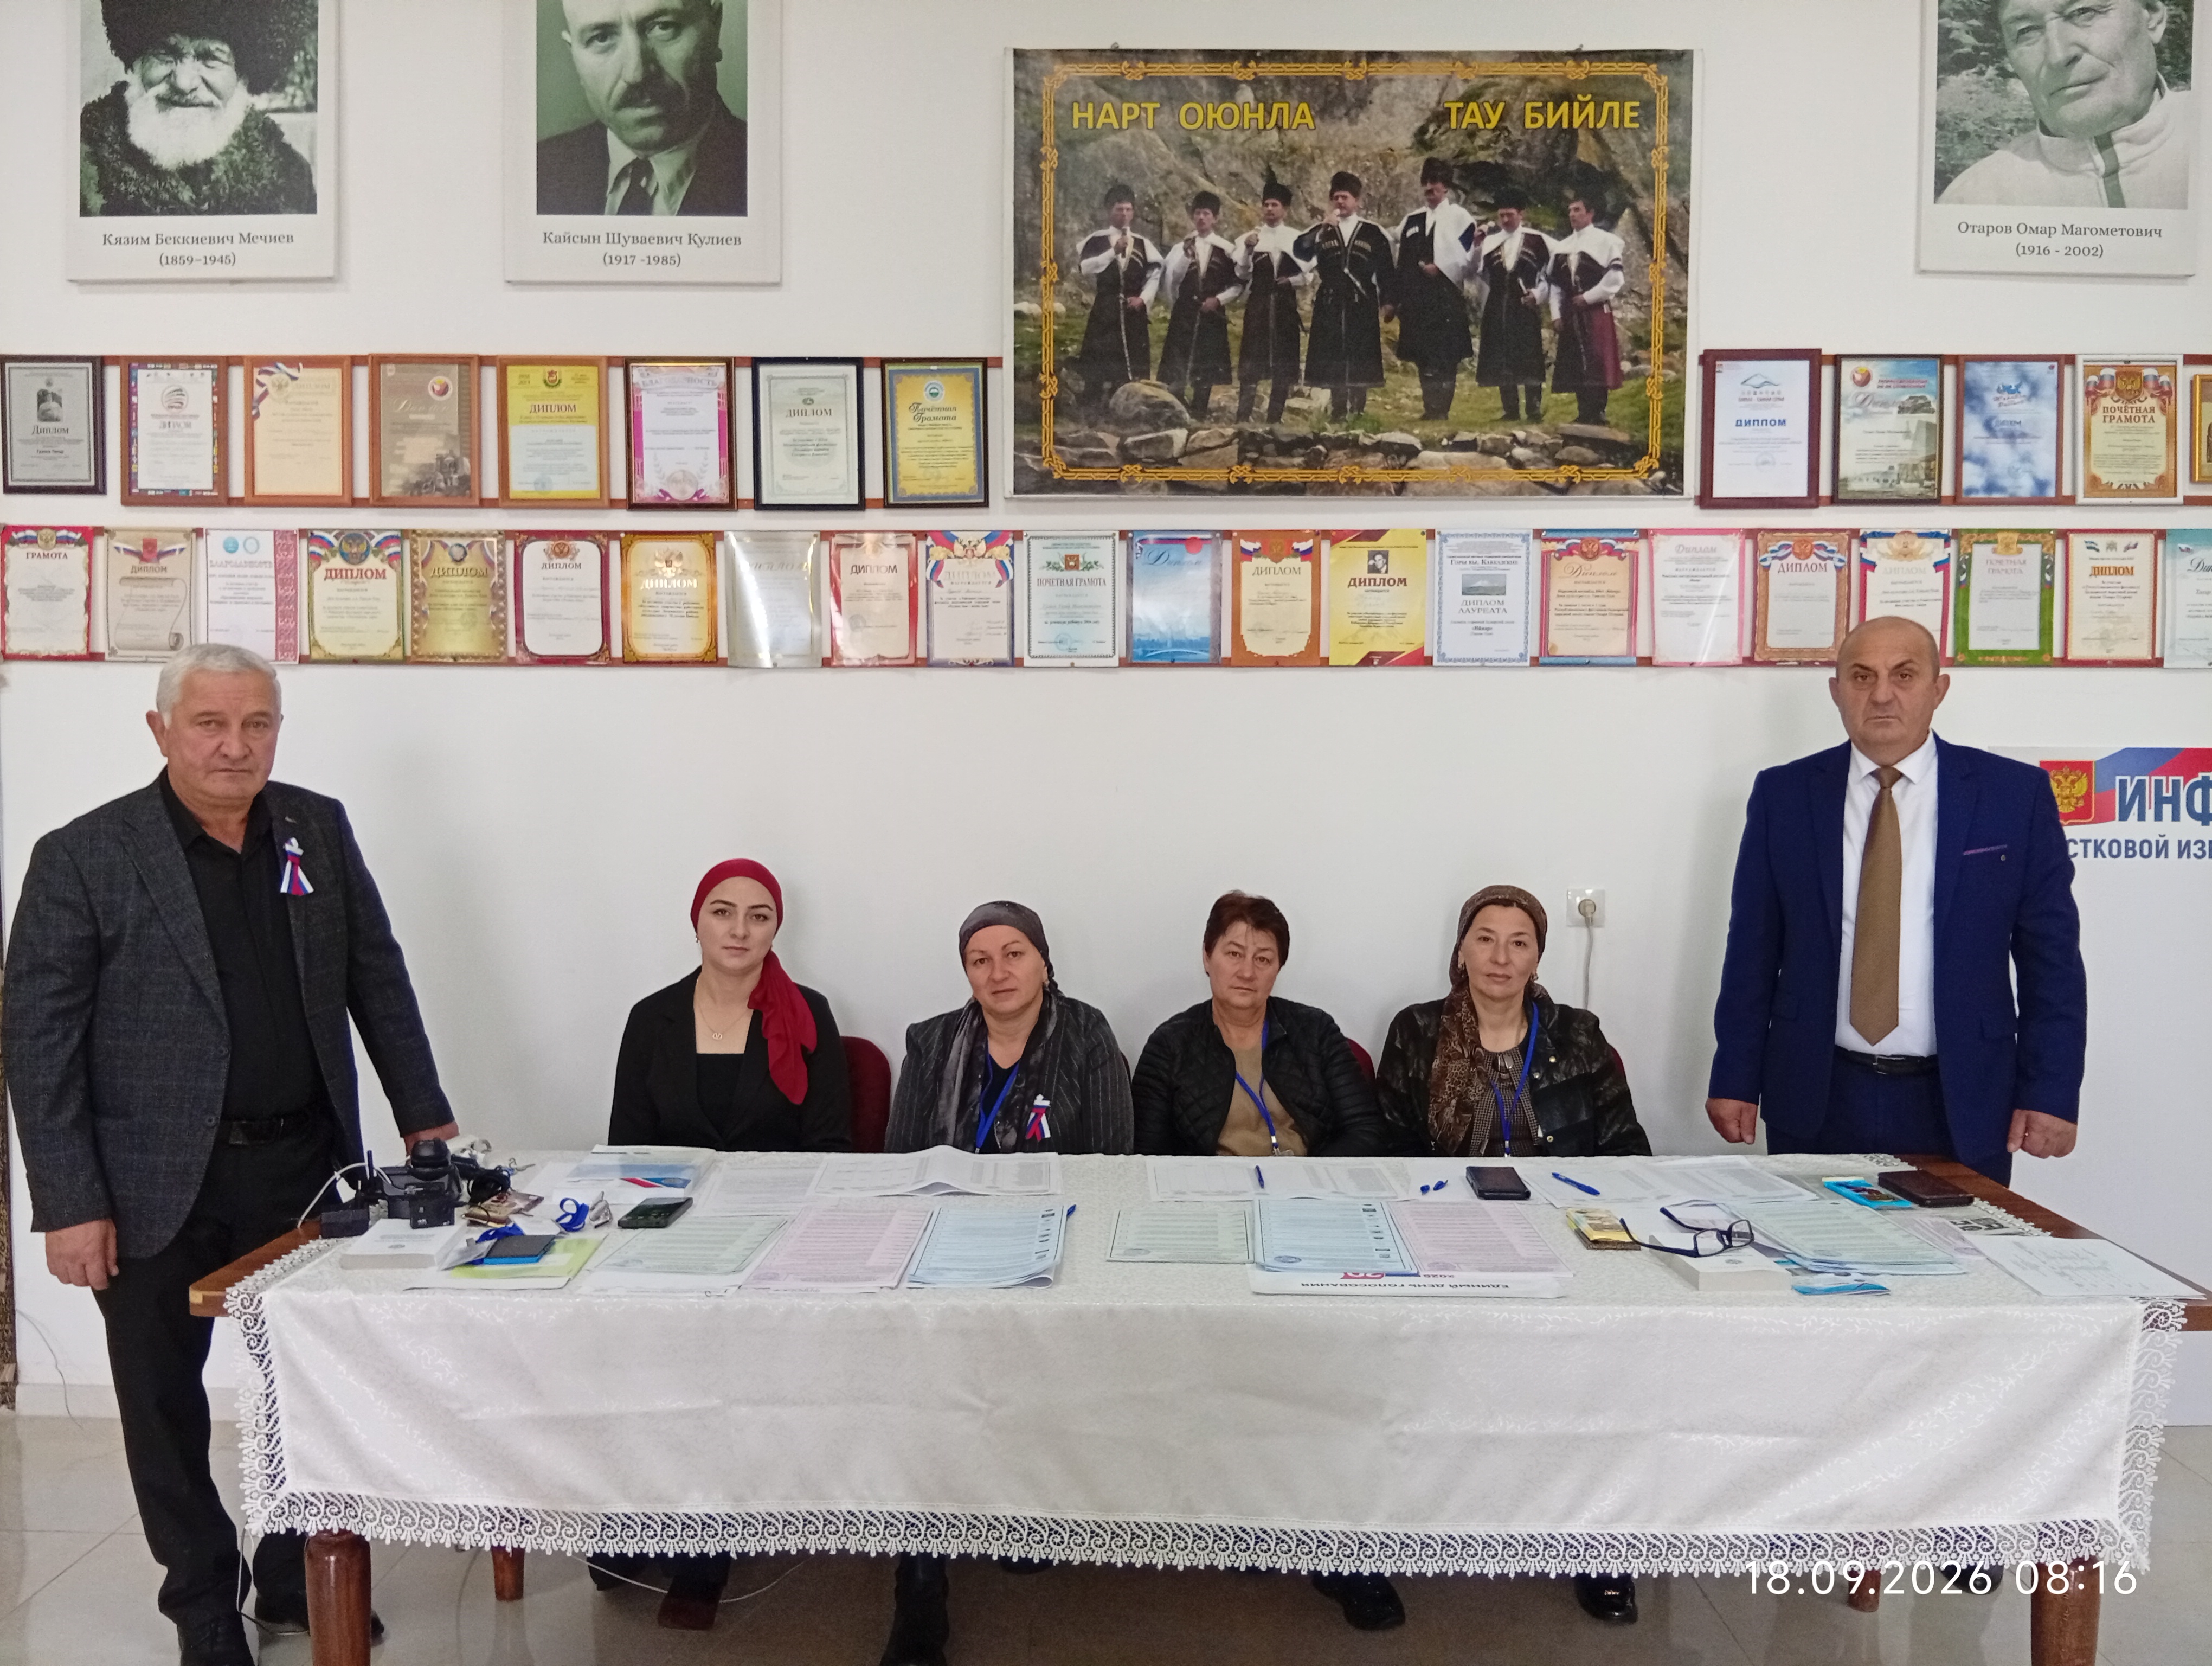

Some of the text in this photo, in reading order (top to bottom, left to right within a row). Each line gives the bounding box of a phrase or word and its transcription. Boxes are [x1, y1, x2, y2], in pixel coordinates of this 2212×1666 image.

[1071, 101, 1316, 132] НАРТ ОЮНЛА
[1443, 97, 1641, 130] ТАУ БИЙЛЕ
[1957, 220, 2163, 239] Отаров Омар Магометович
[101, 232, 294, 246] Кязим Беккиевич Мечиев
[542, 230, 742, 249] Кайсын Шуваевич Кулиев
[2015, 242, 2051, 258] (1916
[2063, 244, 2105, 259] 2002)
[602, 251, 682, 268] (1917 -1985)
[529, 403, 576, 414] ДИПЛОМ
[786, 408, 832, 418] ДИПЛОМ
[2102, 405, 2156, 413] ПОЧЁТНАЯ
[2102, 415, 2156, 424] ГРАМОТА
[31, 425, 69, 435] Диплом
[130, 565, 168, 574] ДИПЛОМ
[430, 567, 488, 578] ДИПЛОМ
[850, 564, 898, 575] ДИПЛОМ
[1252, 566, 1301, 576] ДИПЛОМ
[1777, 563, 1827, 574] ДИПЛОМ
[2090, 566, 2135, 578] ДИПЛОМ
[324, 568, 387, 581] ДИПЛОМ
[640, 578, 697, 590] ДИПЛОМ
[1075, 578, 1107, 587] ГРАМОТА
[1347, 577, 1407, 588] ДИПЛОМ
[2177, 838, 2212, 859] ИЗ
